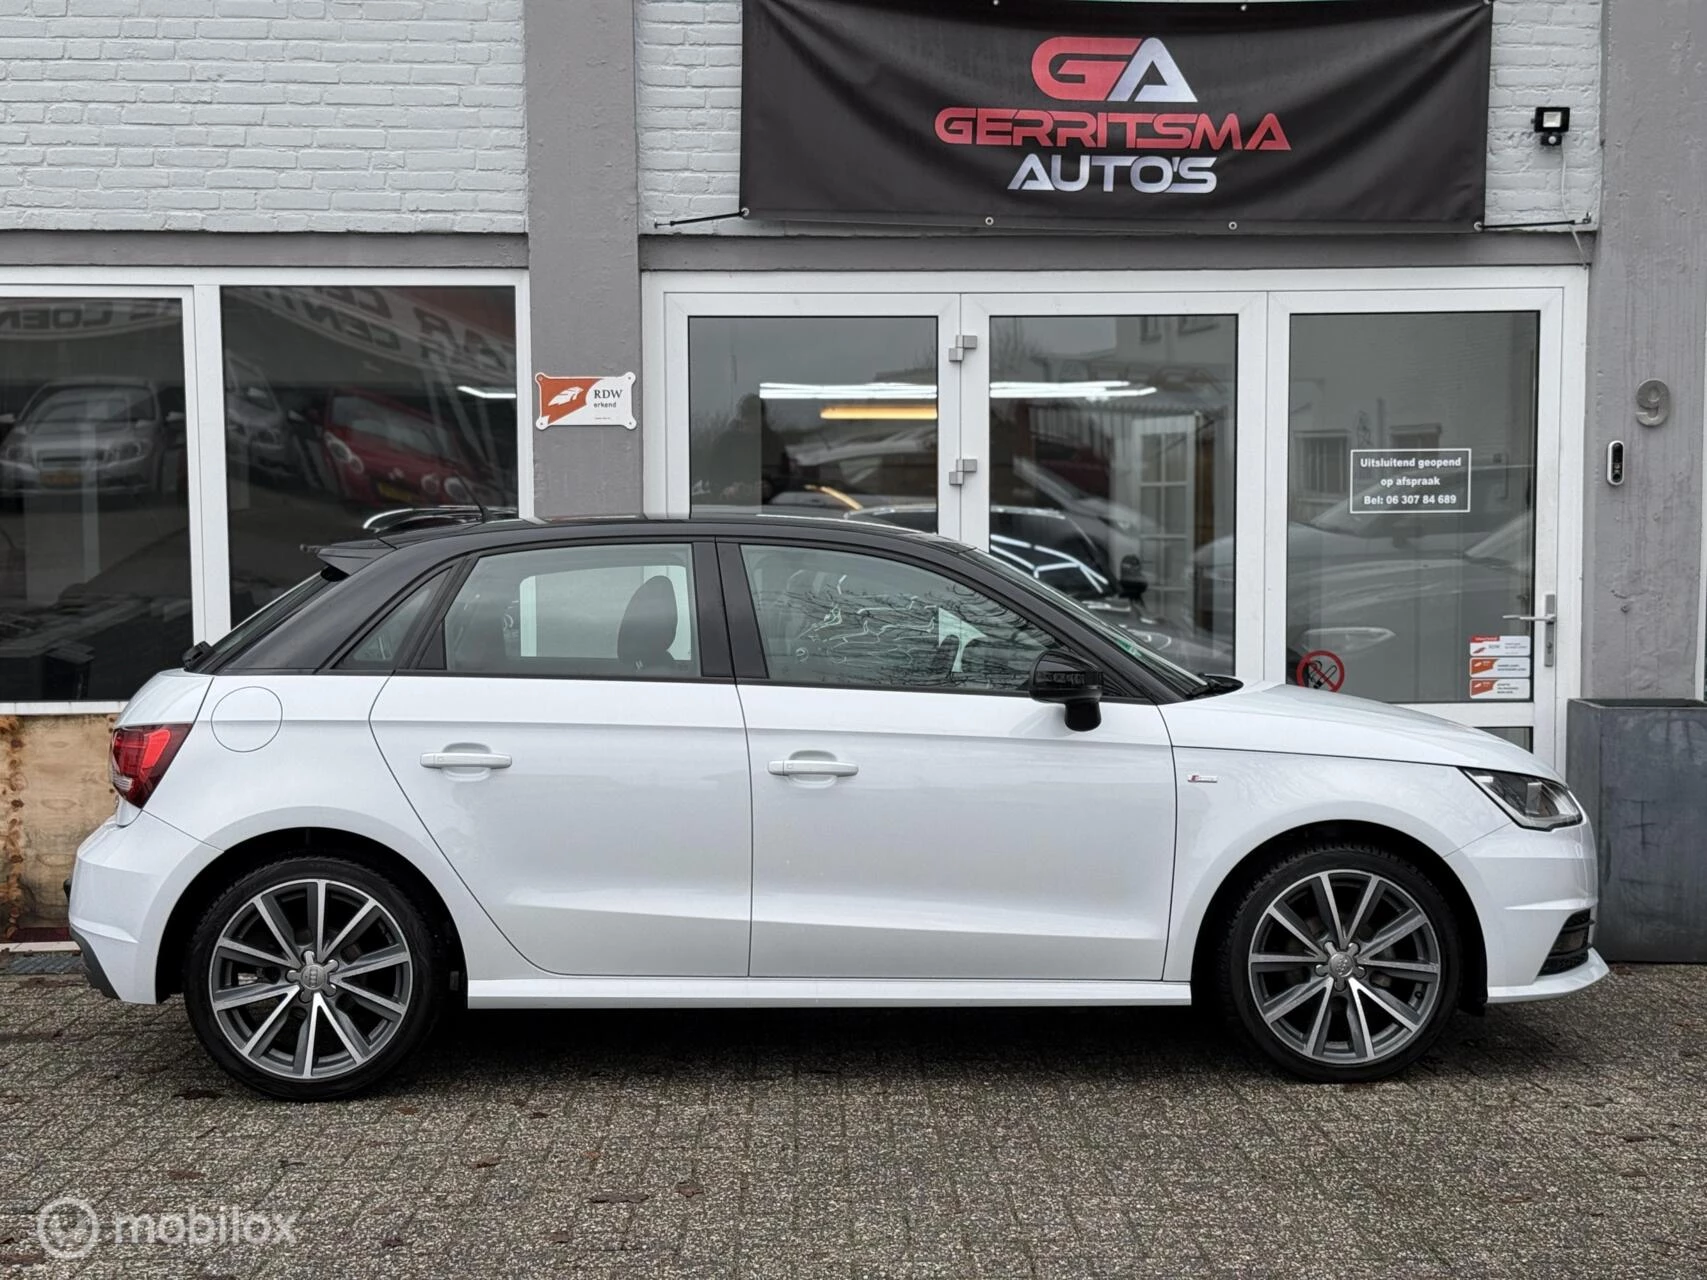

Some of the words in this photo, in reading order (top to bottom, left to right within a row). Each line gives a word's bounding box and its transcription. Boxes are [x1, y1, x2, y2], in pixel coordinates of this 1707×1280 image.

[1031, 36, 1198, 102] GA
[934, 107, 1291, 150] GERRITSMA
[1007, 153, 1217, 193] AUTO'S
[593, 389, 623, 399] RDW
[1635, 379, 1670, 427] 9
[1360, 458, 1415, 467] Uitsluitend
[1418, 457, 1461, 468] geopend
[1380, 479, 1394, 488] op
[1396, 476, 1440, 487] afspraak
[1364, 495, 1384, 505] Bel:
[1386, 495, 1399, 504] 06
[1401, 495, 1420, 504] 307
[1422, 494, 1435, 504] 84
[1437, 494, 1457, 504] 689
